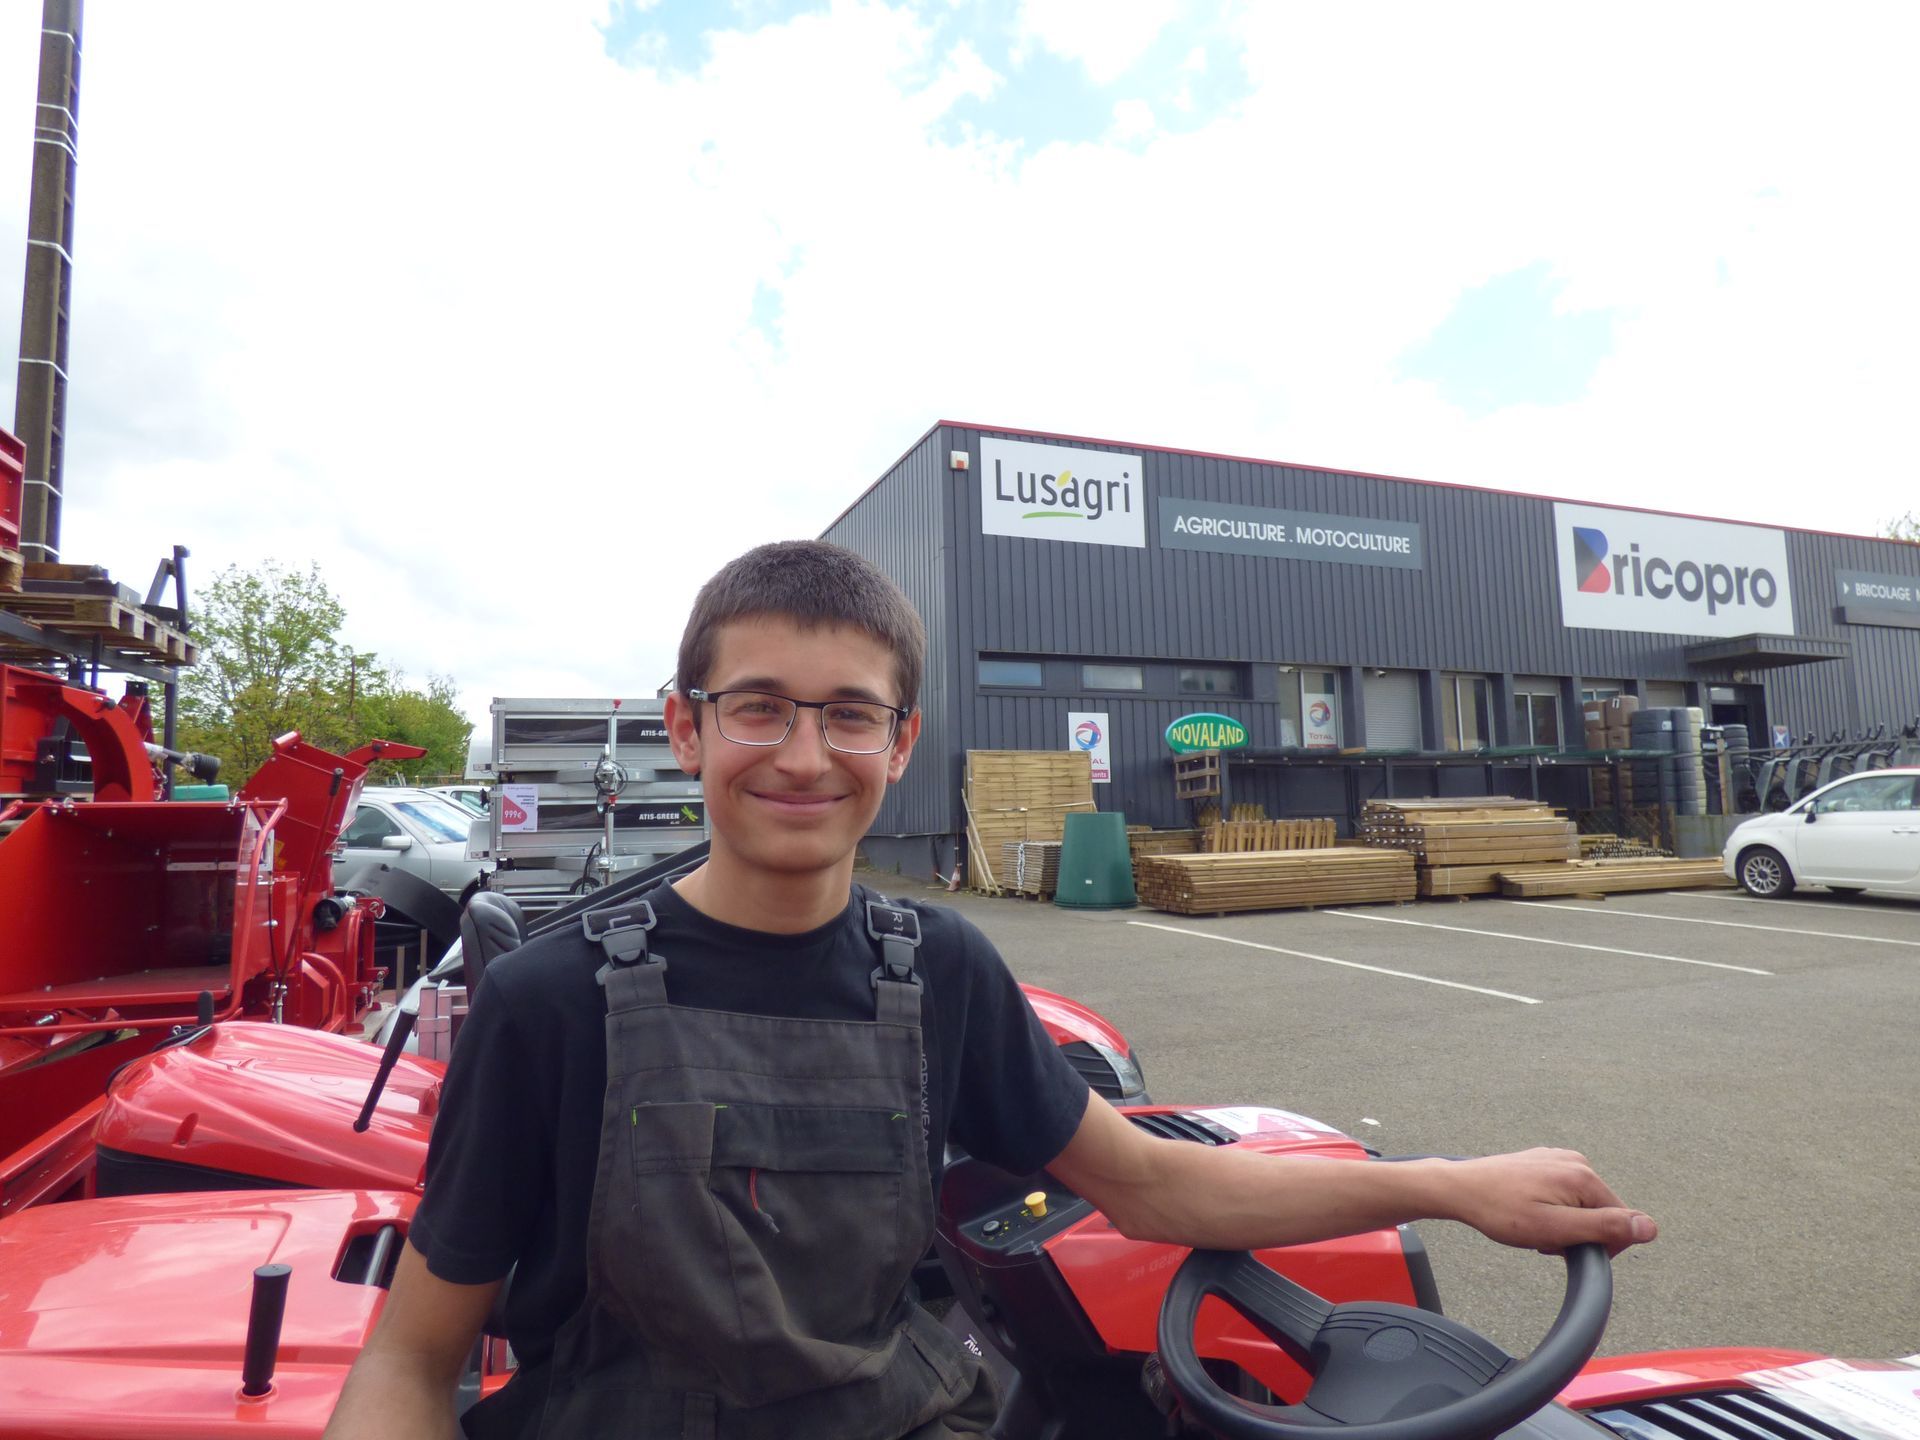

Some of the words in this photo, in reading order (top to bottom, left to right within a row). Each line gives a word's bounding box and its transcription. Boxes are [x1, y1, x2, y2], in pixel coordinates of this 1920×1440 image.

[995, 458, 1130, 520] Lusagri
[1173, 515, 1286, 542] AGRICULTURE
[1296, 526, 1411, 554] MOTOCULTURE
[1572, 526, 1777, 616] Bricopro
[1855, 582, 1911, 601] BRICOLAGE
[1172, 722, 1245, 747] NOVALAND
